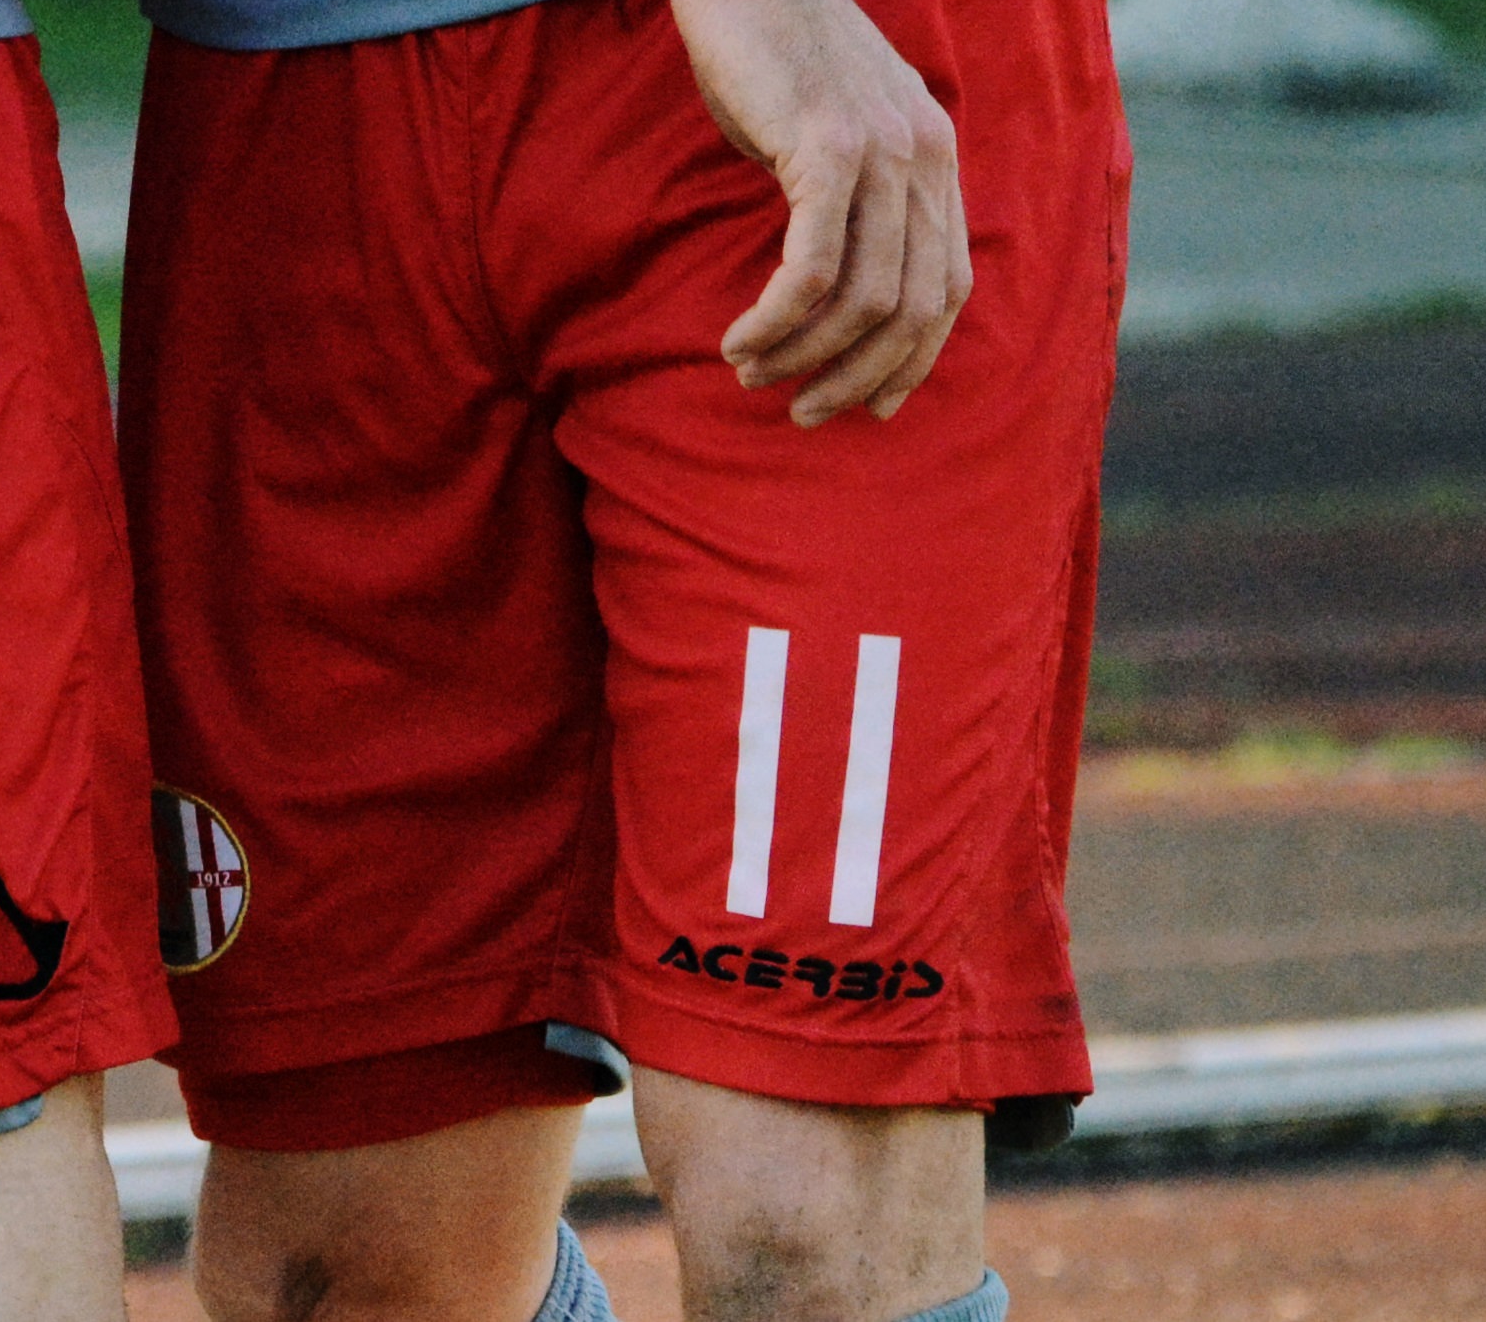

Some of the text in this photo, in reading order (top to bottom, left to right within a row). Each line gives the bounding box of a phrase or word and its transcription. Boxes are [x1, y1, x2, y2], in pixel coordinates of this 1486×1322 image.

[726, 626, 901, 927] 11
[196, 872, 231, 886] 1912
[658, 936, 944, 1000] ACERBIS
